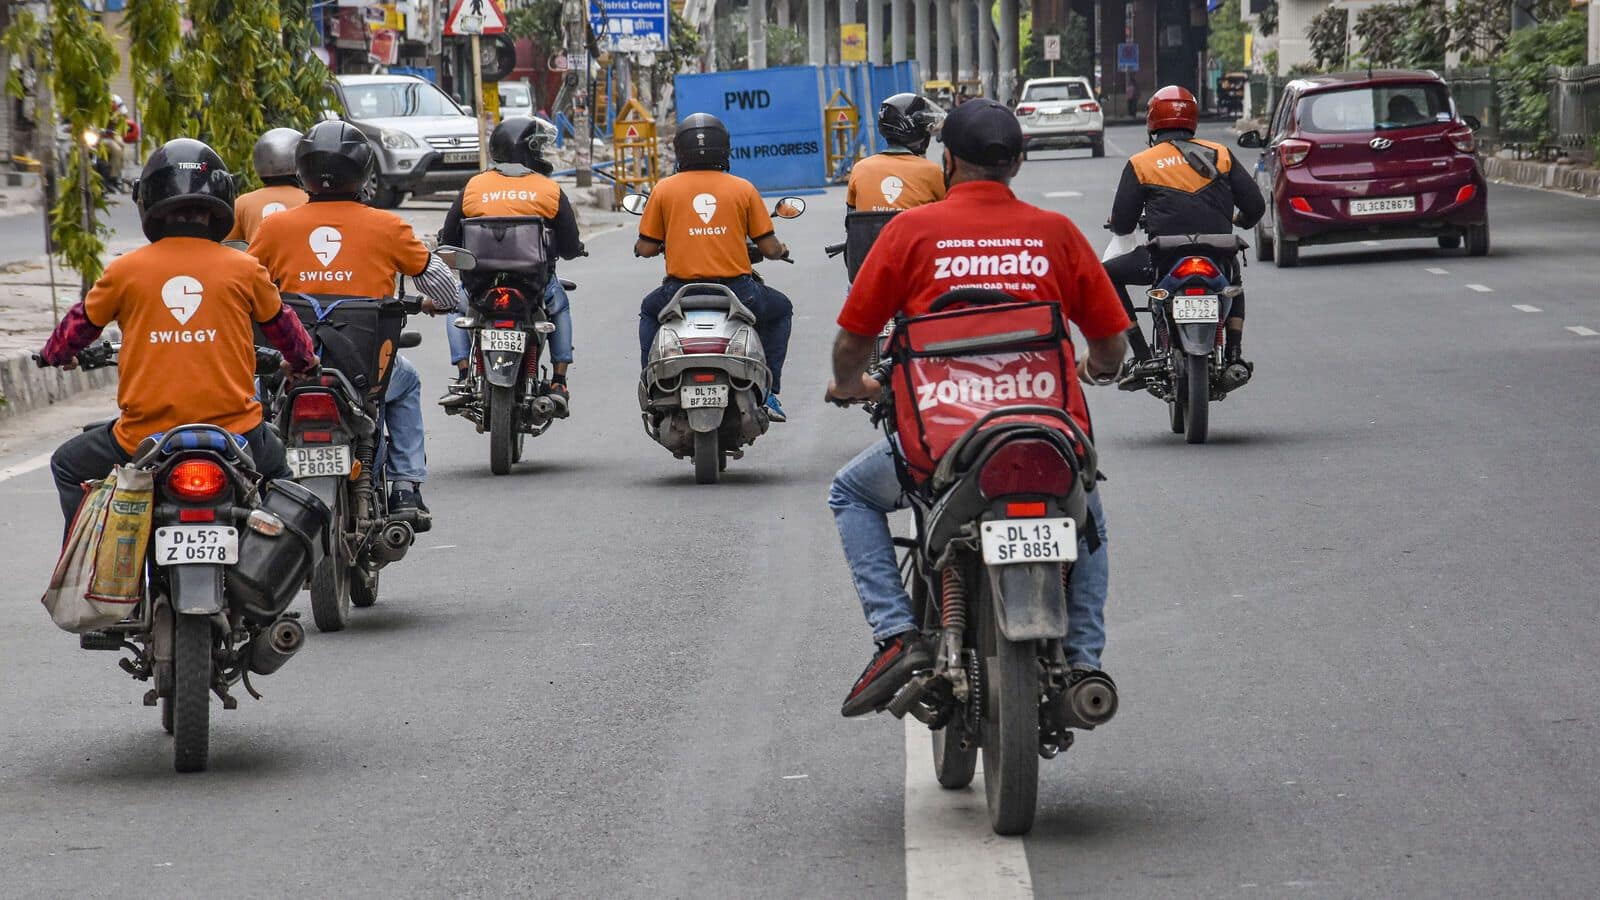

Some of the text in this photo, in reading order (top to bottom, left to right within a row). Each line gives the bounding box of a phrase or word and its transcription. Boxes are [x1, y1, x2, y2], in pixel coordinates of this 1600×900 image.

[601, 1, 662, 10] istrict Centre
[725, 90, 770, 111] PWD
[754, 141, 818, 158] PROGRESS
[482, 190, 537, 203] SWIGGY
[688, 226, 727, 236] SWIGGY
[936, 239, 1043, 249] ORDER ONLINE ON
[934, 250, 1050, 279] zomato
[299, 271, 353, 281] SWIGGY
[150, 329, 217, 343] SWIGGY
[917, 367, 1056, 412] zomato
[298, 447, 343, 462] DL3SE
[299, 461, 344, 476] F8035
[1007, 525, 1052, 541] DL 13
[167, 546, 226, 561] Z 0578
[998, 541, 1060, 560] SF 8851
